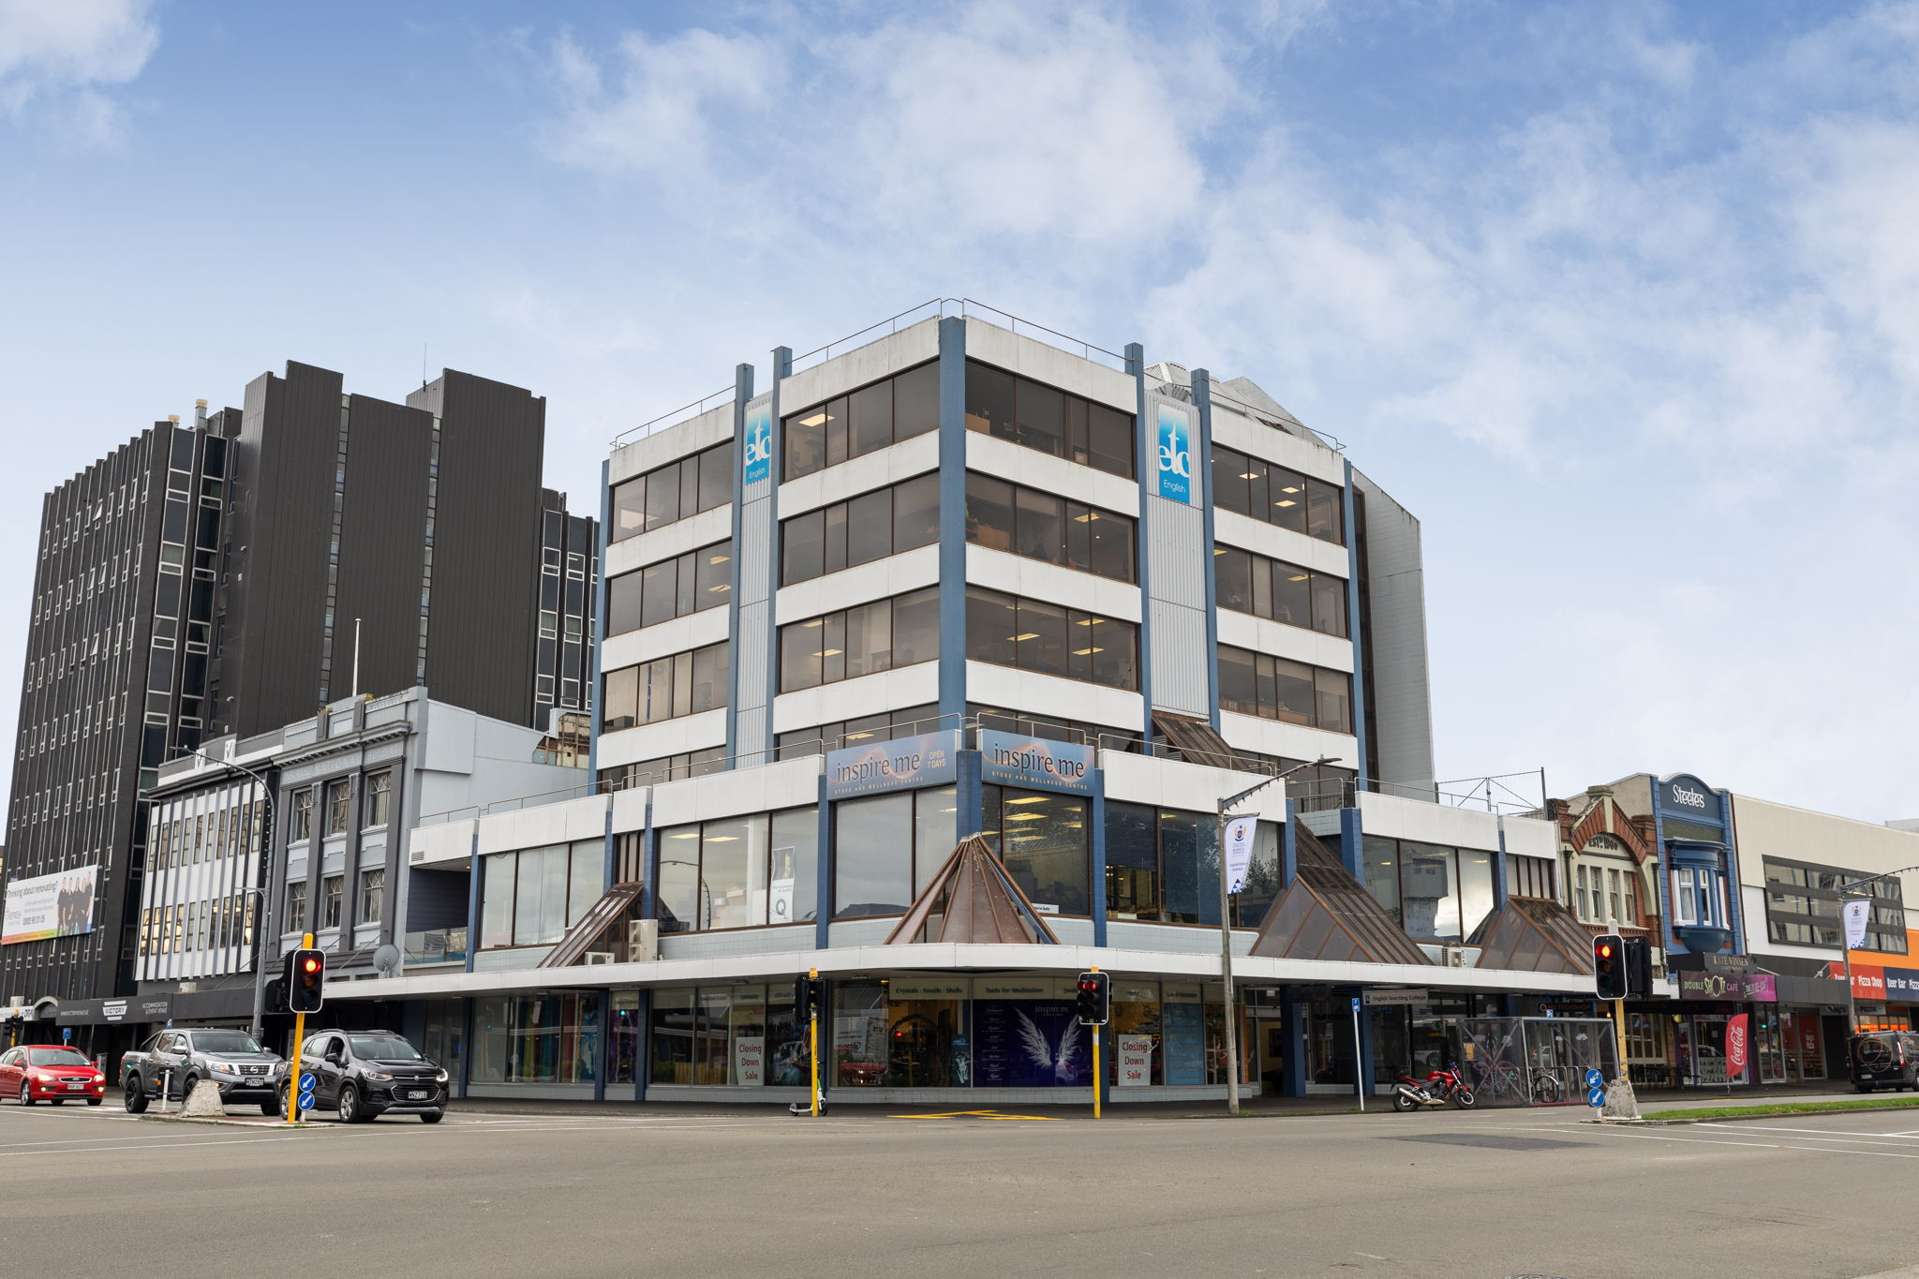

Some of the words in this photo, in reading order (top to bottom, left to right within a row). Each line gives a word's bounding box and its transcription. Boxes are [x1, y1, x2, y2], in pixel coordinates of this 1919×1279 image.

[994, 743, 1053, 773] inspire
[1059, 759, 1085, 778] me
[837, 756, 890, 785] inspire
[895, 753, 920, 773] me
[1672, 783, 1705, 808] Steeles
[739, 1043, 761, 1055] Closing
[1122, 1041, 1147, 1054] Closing
[742, 1057, 759, 1067] Down
[1125, 1056, 1144, 1066] Down
[744, 1071, 758, 1080] Sale
[1127, 1070, 1141, 1080] Sale
